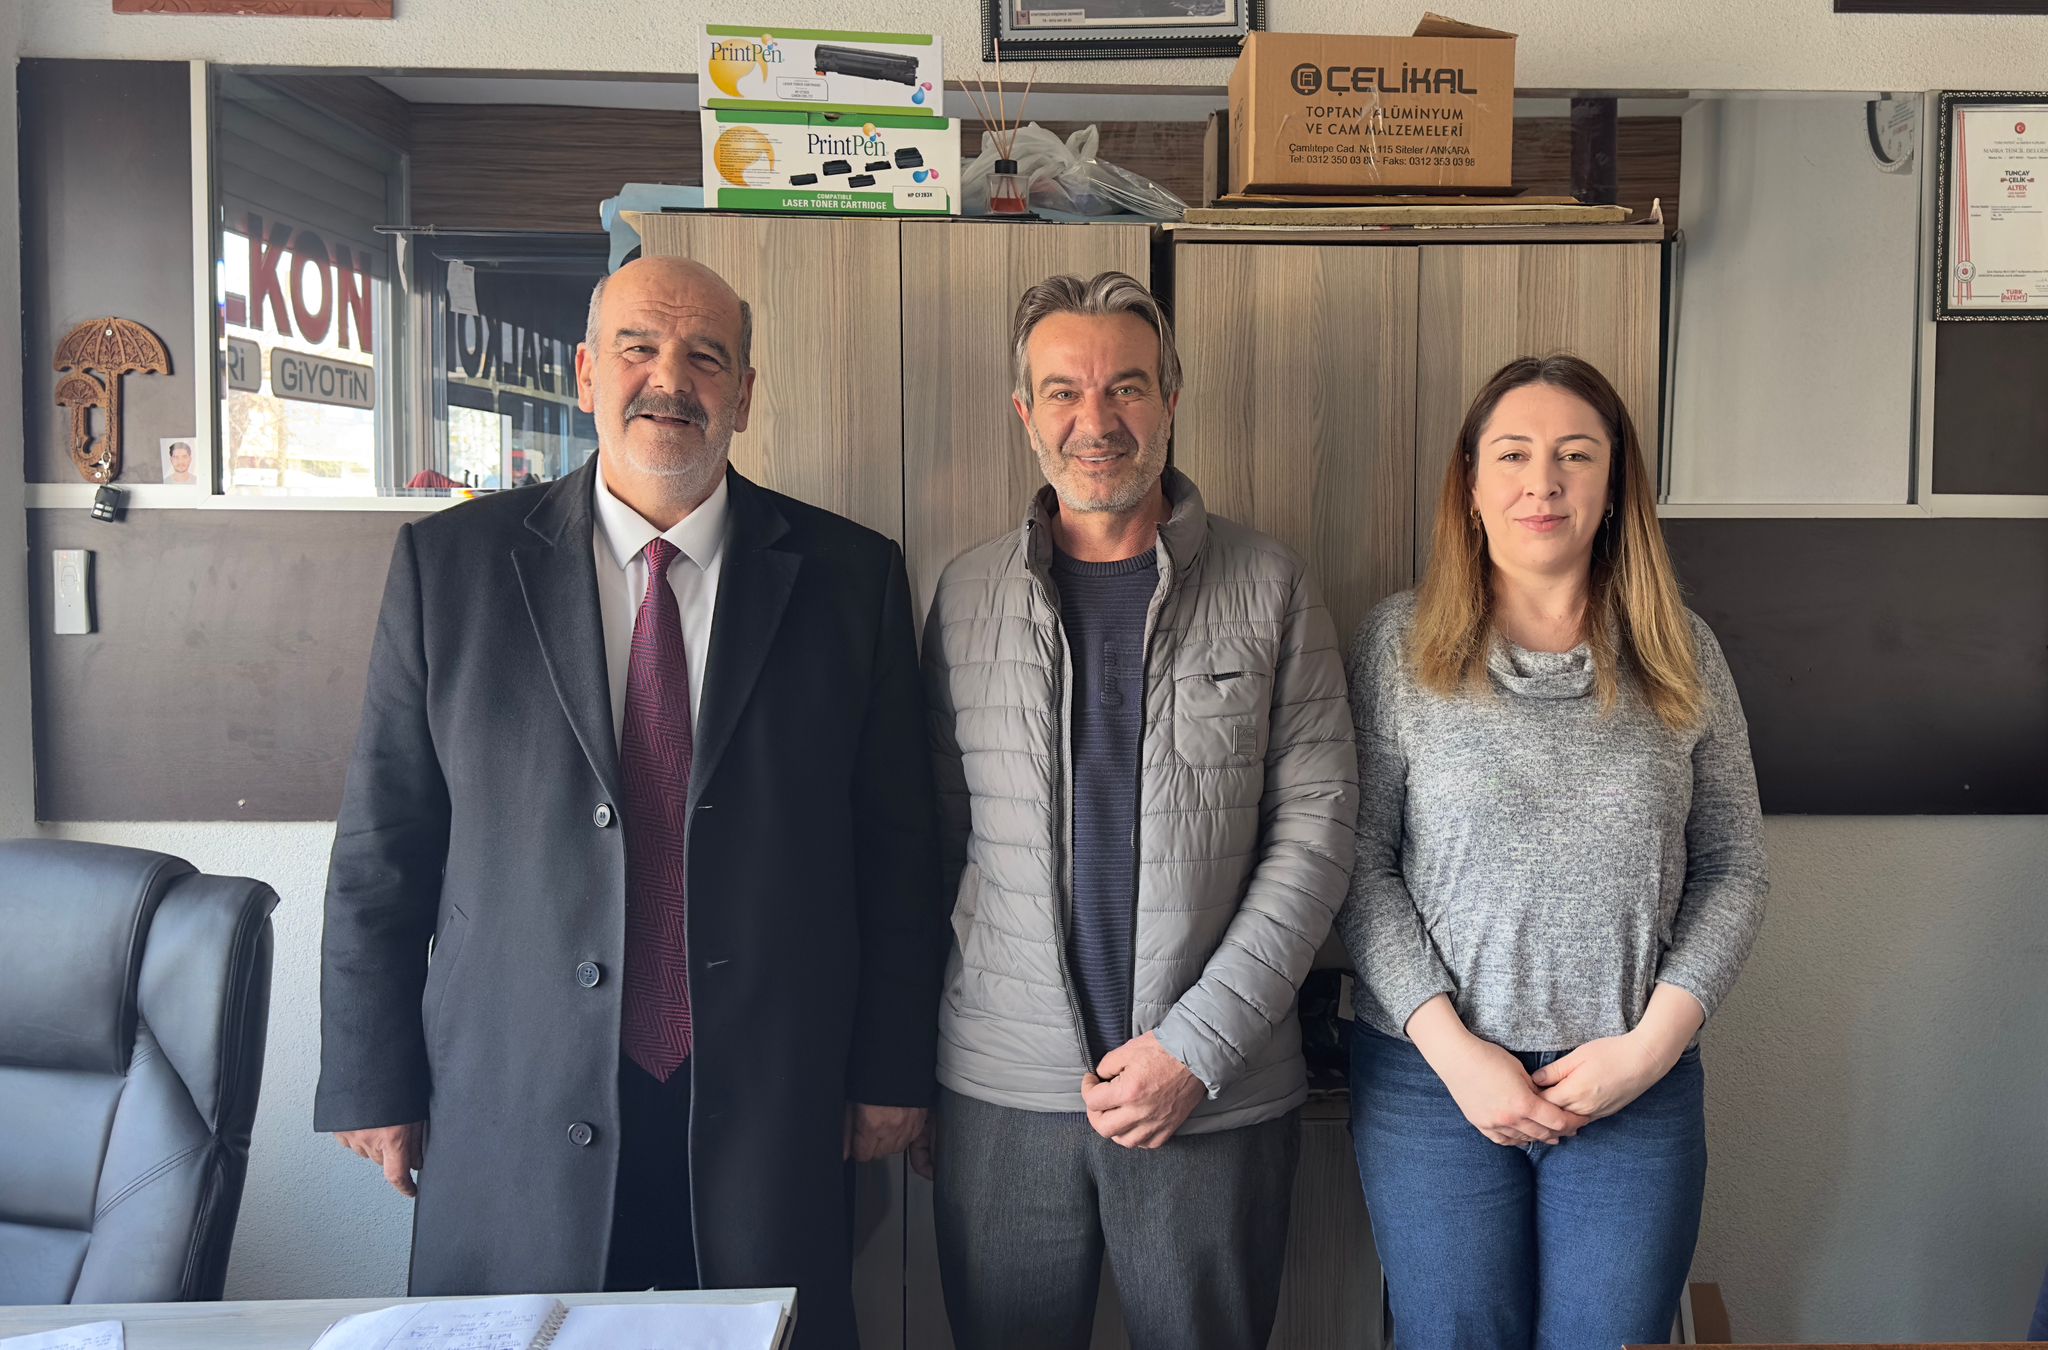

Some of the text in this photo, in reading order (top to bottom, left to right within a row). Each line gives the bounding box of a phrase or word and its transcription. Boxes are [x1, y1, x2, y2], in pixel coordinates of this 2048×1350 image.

[711, 42, 782, 63] PrintPen
[1327, 62, 1477, 96] ÇELİKAL
[1306, 105, 1464, 120] TOPTAN ALÜMİNYUM
[1306, 123, 1463, 137] VE CAM MALZEMELERİ
[808, 133, 886, 157] PrintPen
[1377, 145, 1393, 154] 115
[1395, 145, 1424, 154] Siteler
[1430, 145, 1470, 155] ANKARA
[1306, 155, 1329, 164] 0312
[1331, 155, 1348, 164] 350
[1350, 156, 1361, 165] 03
[1382, 156, 1407, 166] Faks:
[1409, 156, 1432, 166] 0312
[1452, 157, 1464, 167] 03
[782, 199, 887, 210] LASER TONER CARTRIDGE
